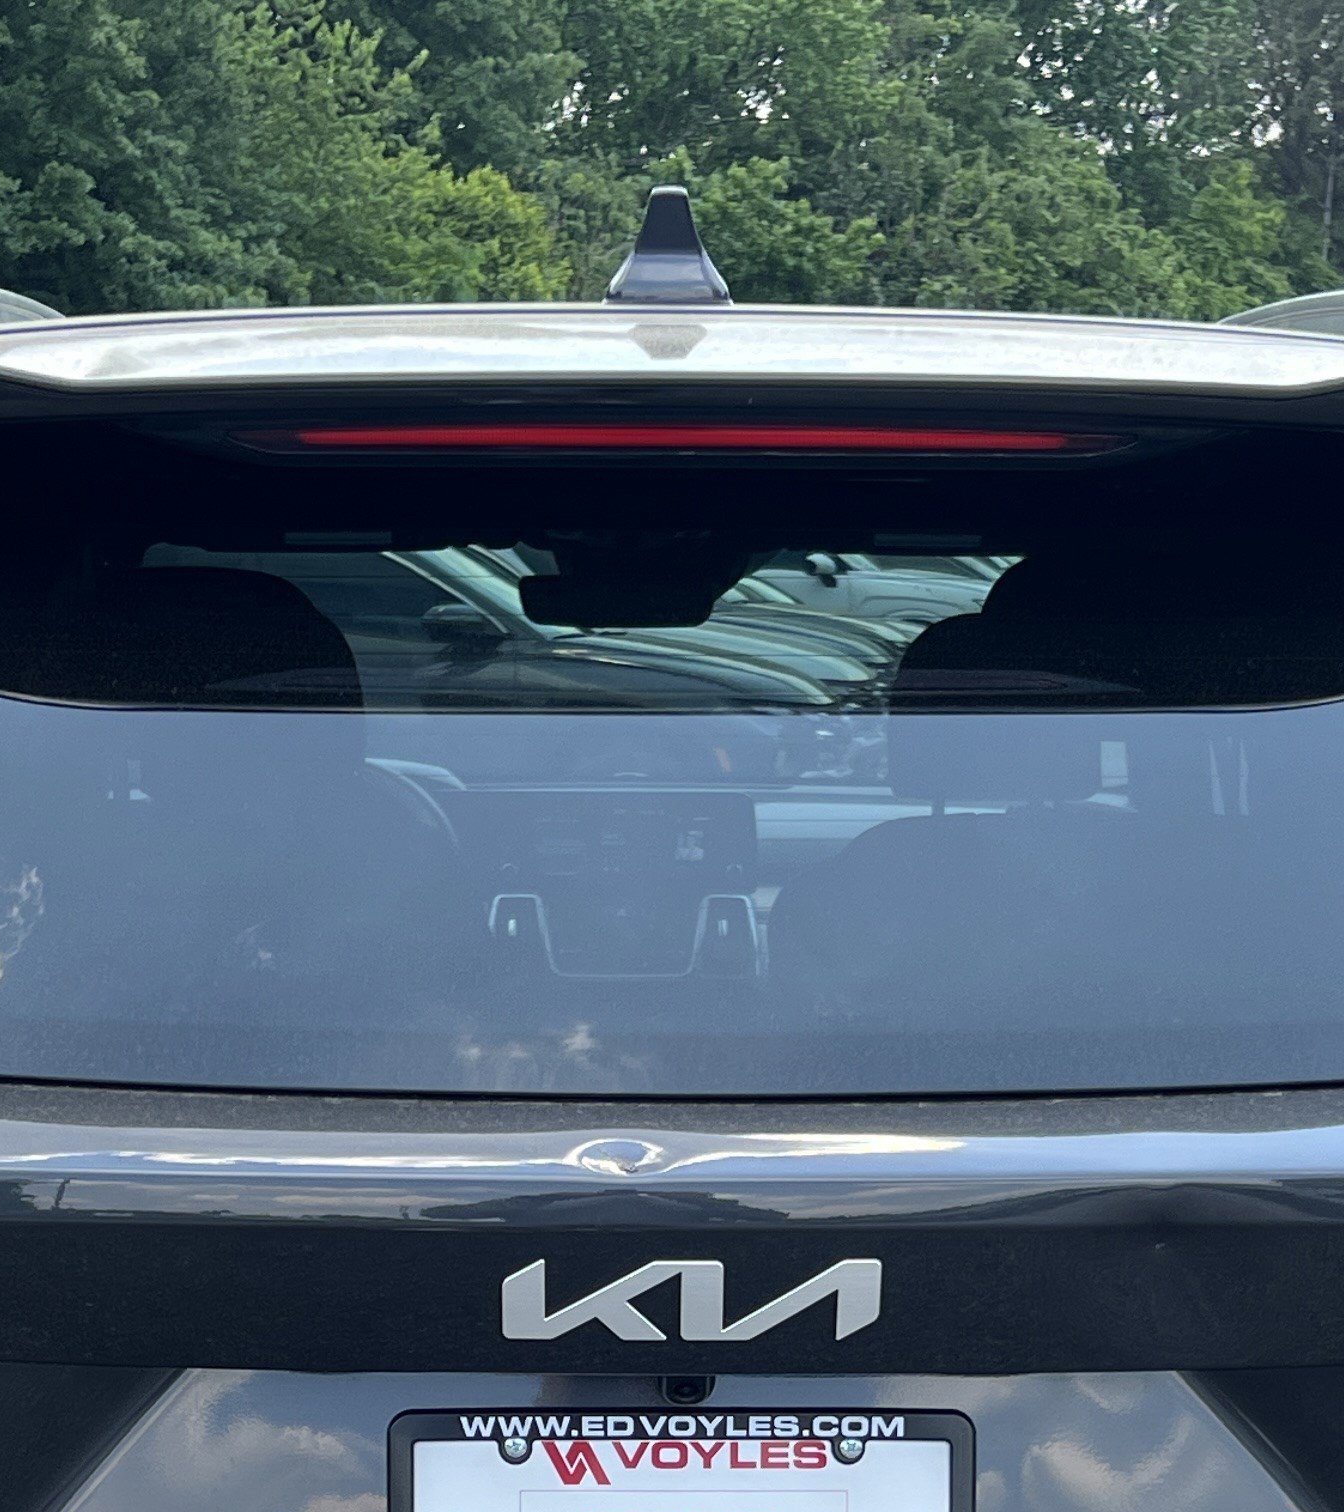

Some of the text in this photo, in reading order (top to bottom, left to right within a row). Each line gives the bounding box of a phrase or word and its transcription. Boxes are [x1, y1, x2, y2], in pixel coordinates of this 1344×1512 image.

[502, 1258, 883, 1341] KIA
[459, 1415, 905, 1438] WWW.EDVOYLES.COM
[612, 1441, 828, 1469] VOYLES
